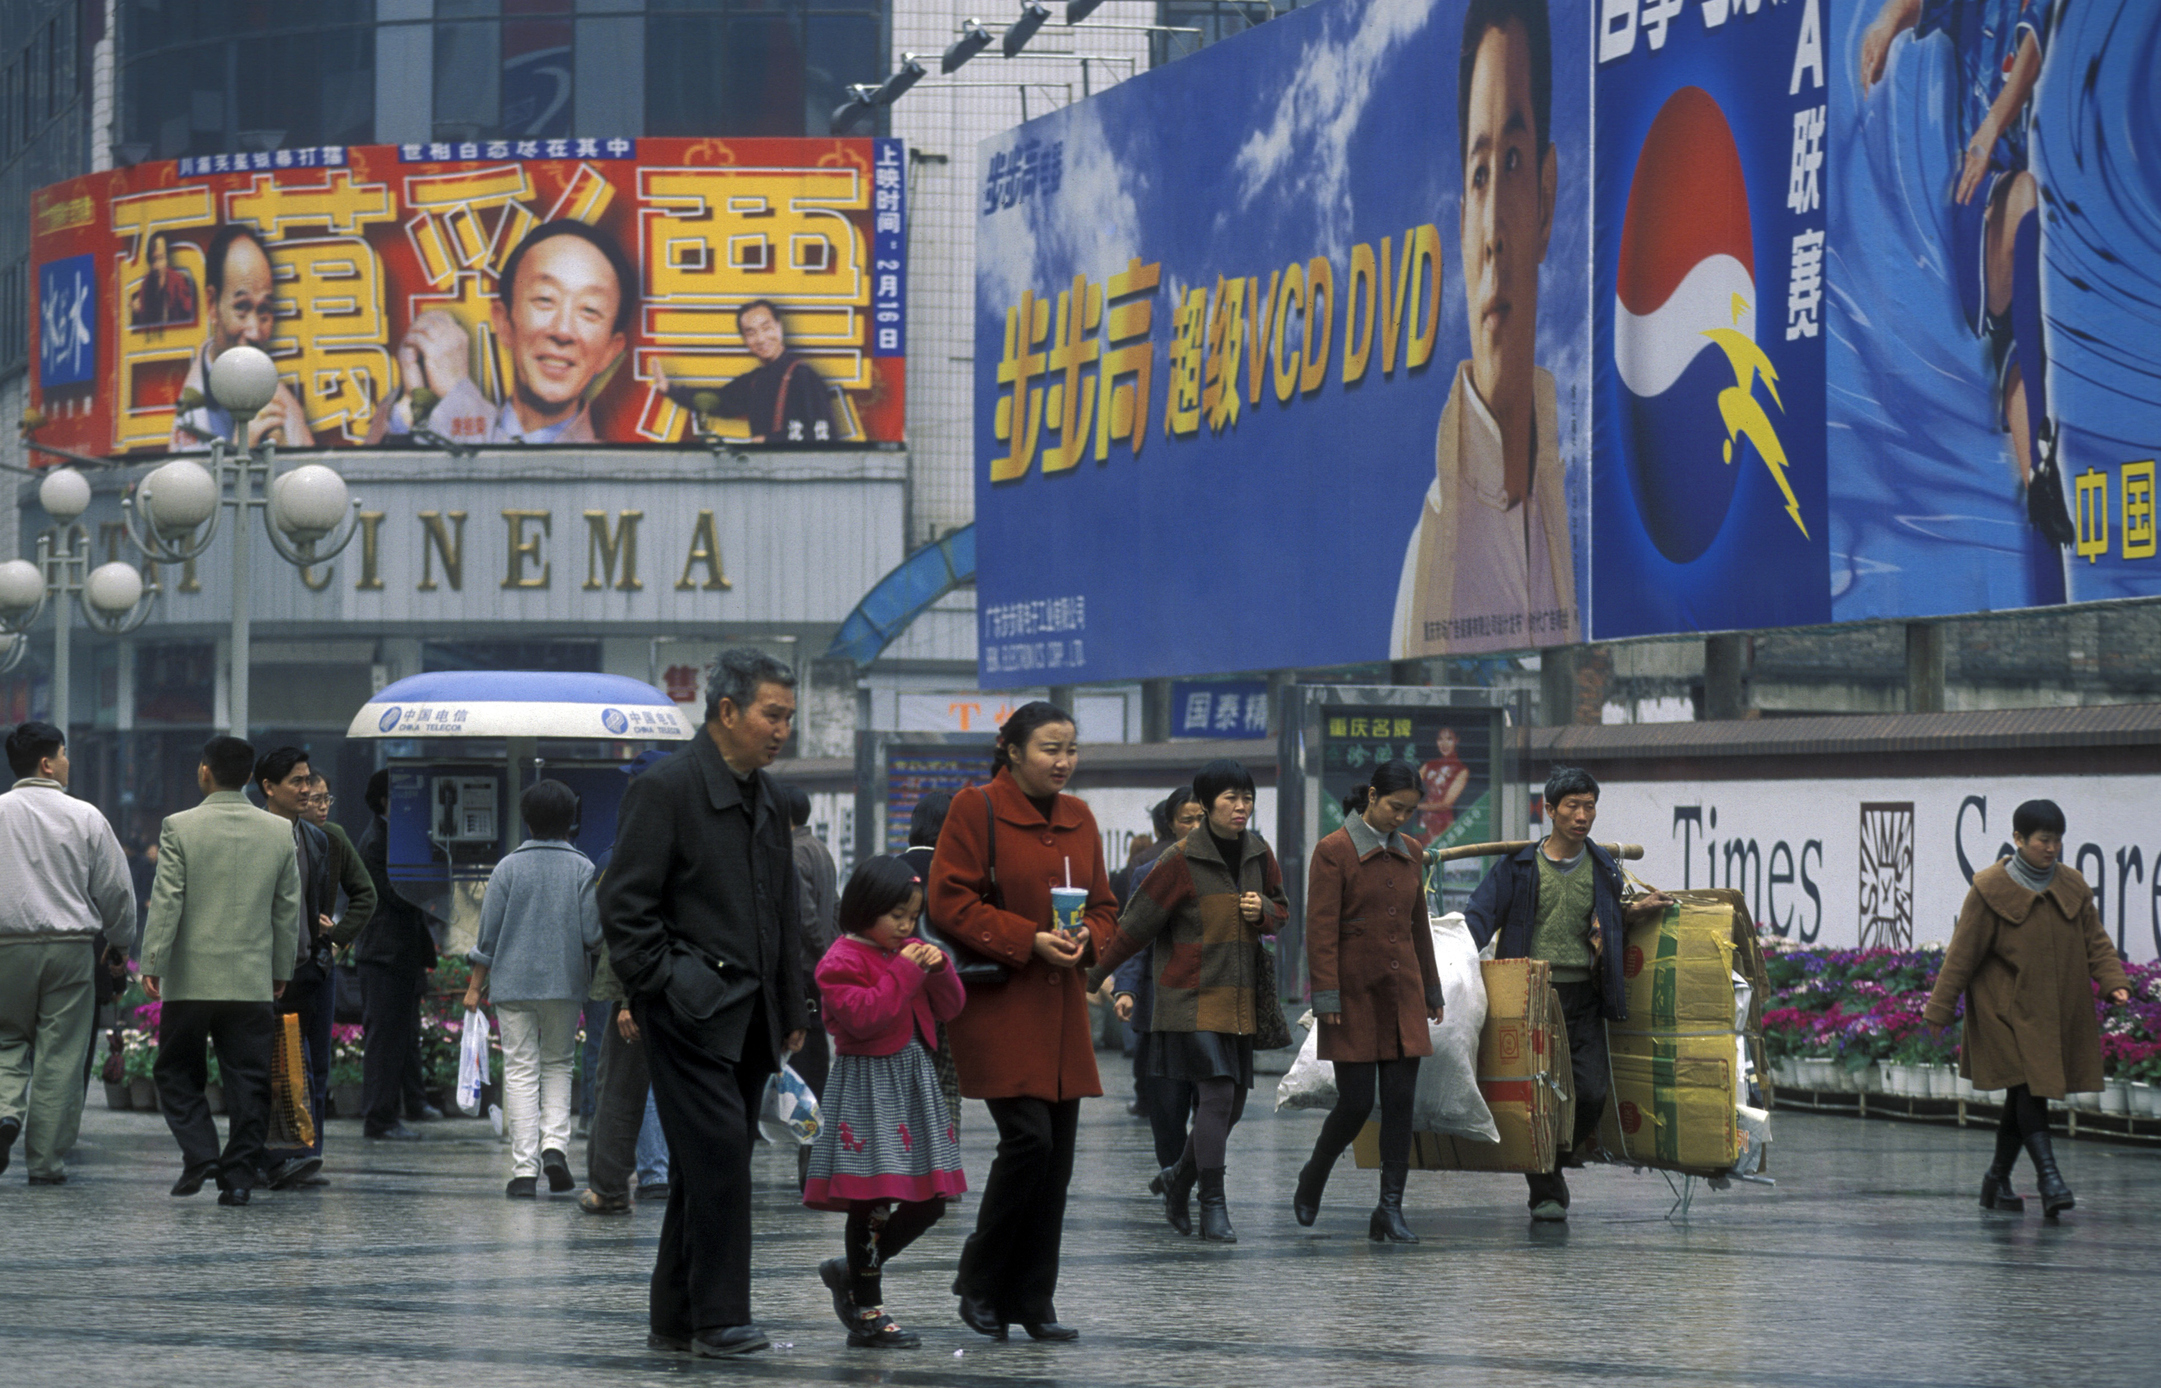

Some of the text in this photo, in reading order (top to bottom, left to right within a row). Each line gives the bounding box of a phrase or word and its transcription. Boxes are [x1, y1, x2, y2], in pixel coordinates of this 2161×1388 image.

[990, 256, 1161, 482] 步步高
[1342, 223, 1442, 384] DVD
[2075, 460, 2157, 564] 中国
[404, 708, 468, 723] 中国电信
[1329, 717, 1412, 738] 重庆名牌
[1673, 805, 1823, 944] Times
